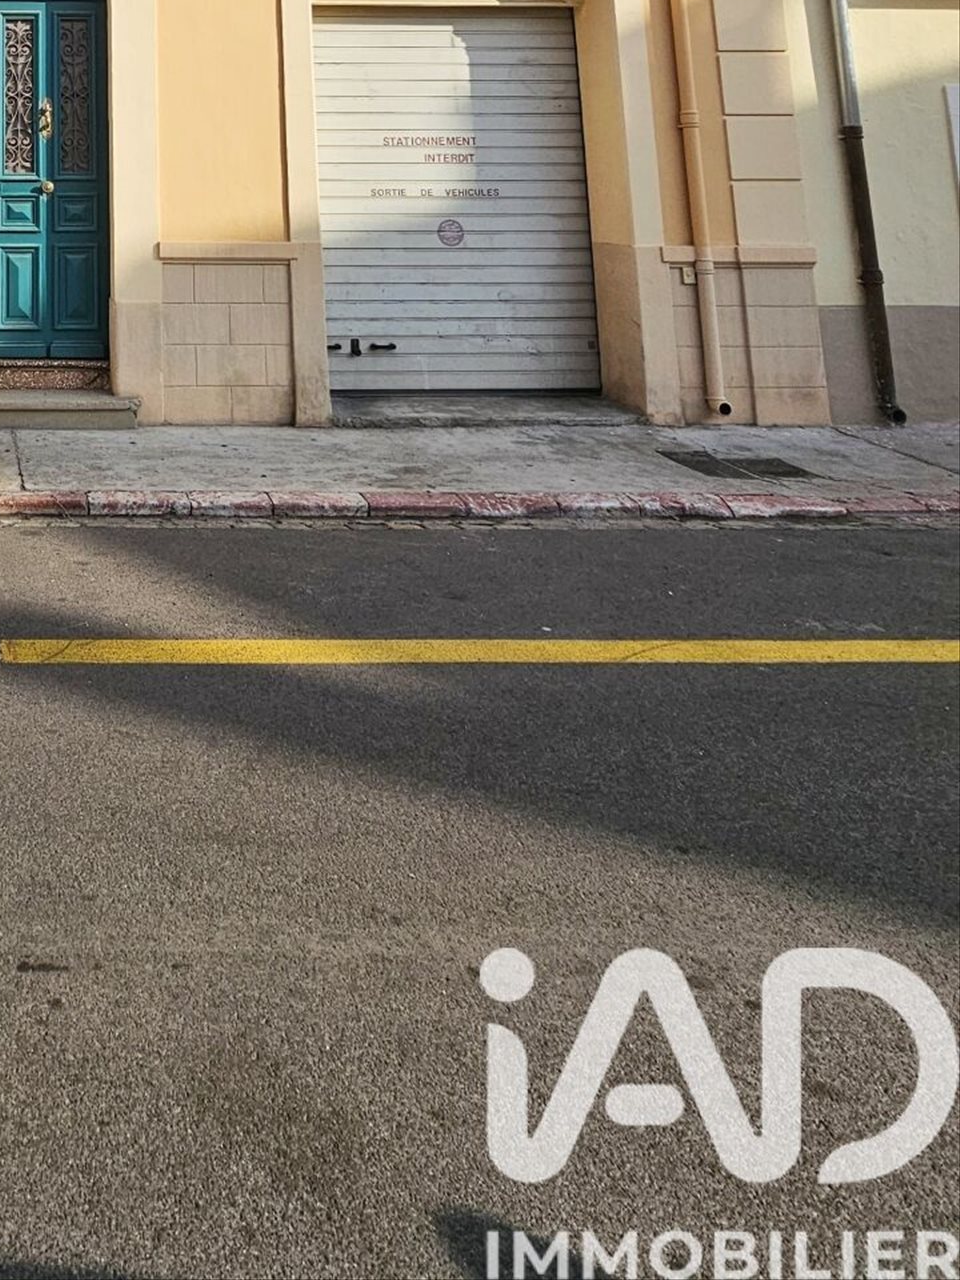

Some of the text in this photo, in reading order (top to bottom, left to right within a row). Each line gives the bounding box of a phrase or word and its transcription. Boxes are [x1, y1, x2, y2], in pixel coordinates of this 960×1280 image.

[383, 136, 477, 147] STATIONNEMENT
[424, 153, 475, 163] INTERDIT
[370, 188, 500, 197] SORTIE DE VEHICULES
